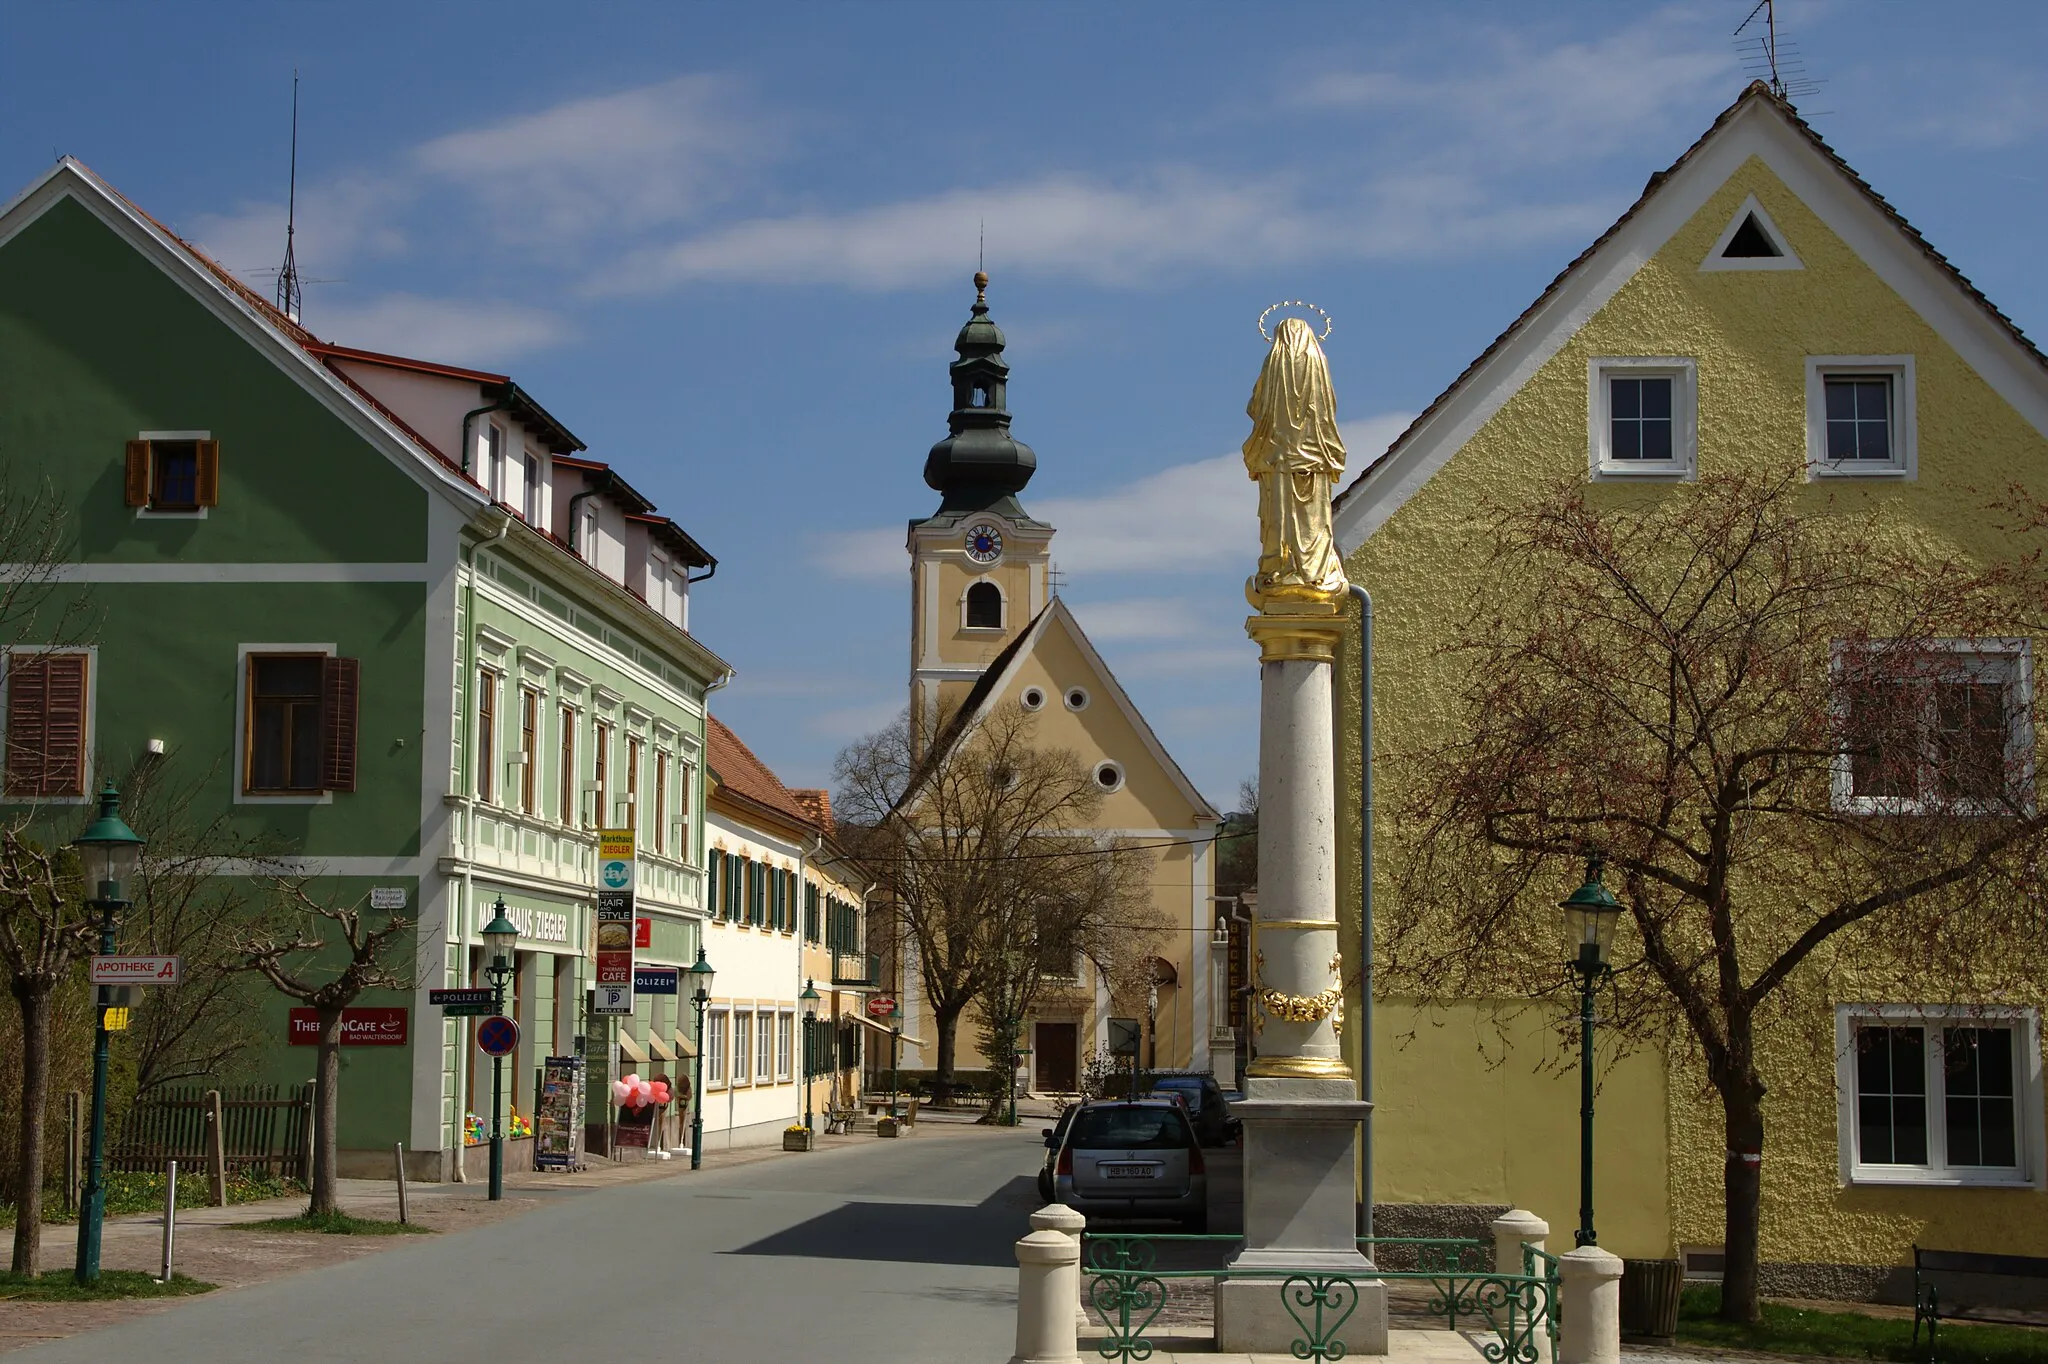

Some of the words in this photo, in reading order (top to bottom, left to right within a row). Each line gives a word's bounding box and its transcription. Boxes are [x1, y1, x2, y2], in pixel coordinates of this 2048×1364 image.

[601, 834, 632, 843] Markthaus
[603, 845, 630, 854] ZIEGLER
[599, 899, 624, 907] HAIR
[599, 912, 630, 920] STYLE
[535, 911, 567, 942] ZIEGLER
[96, 962, 155, 972] APOTHEKE
[602, 972, 627, 981] CAFE
[633, 978, 669, 986] OLIZEI
[443, 993, 482, 1002] POLIZEI
